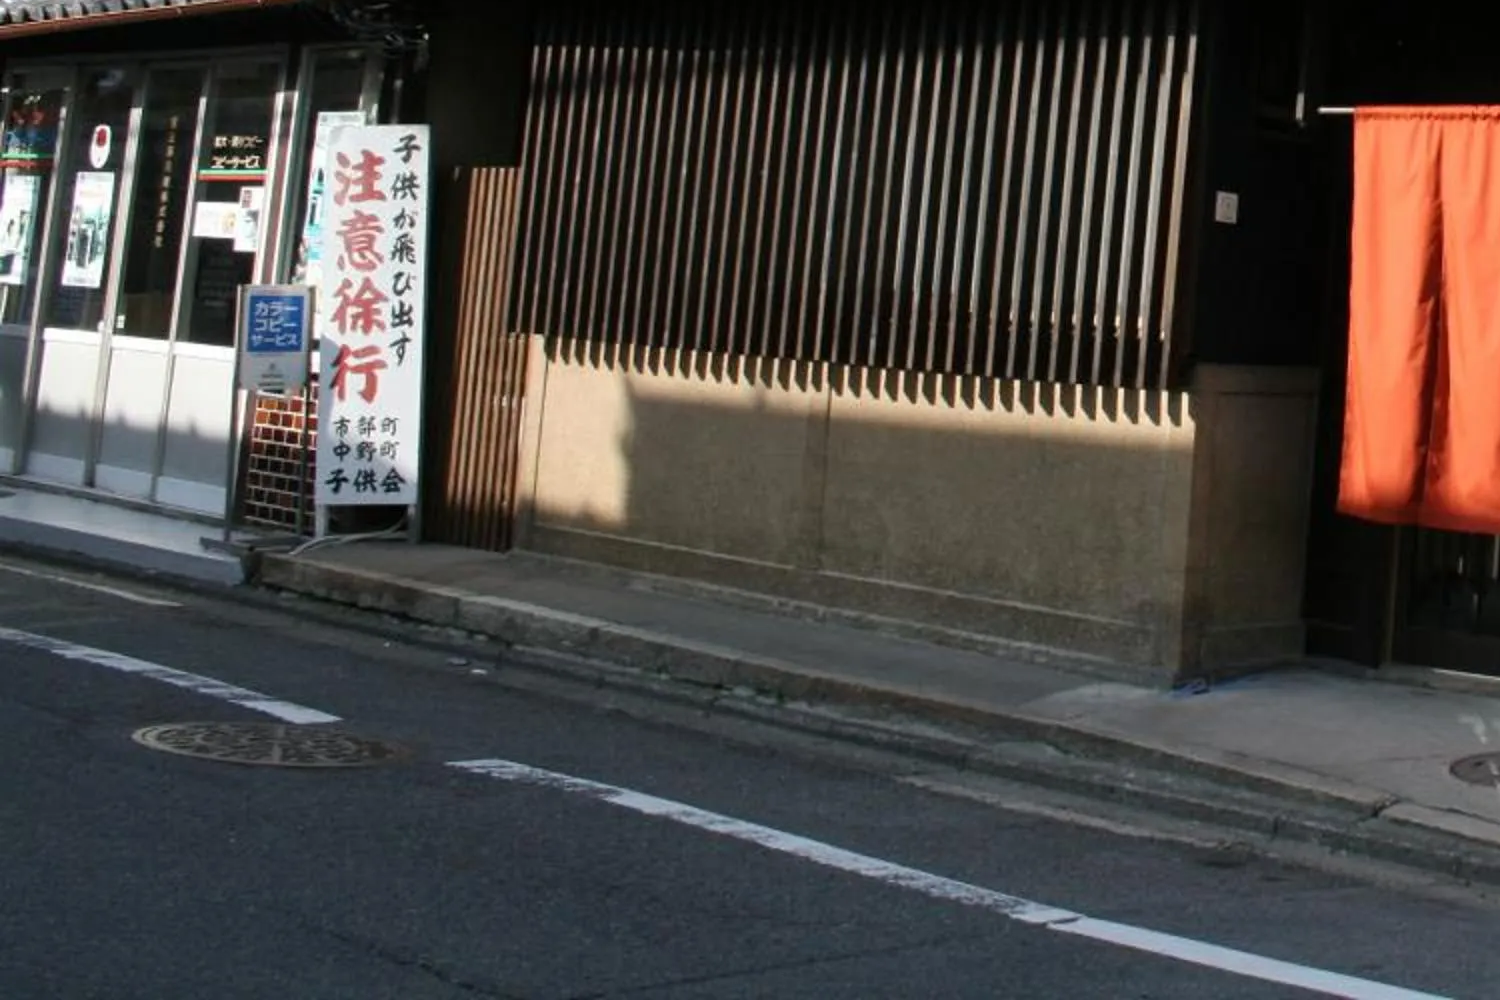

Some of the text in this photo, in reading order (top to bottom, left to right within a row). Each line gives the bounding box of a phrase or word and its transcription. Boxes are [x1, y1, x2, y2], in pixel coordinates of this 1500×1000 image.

[388, 133, 422, 367] 子供が飛び出す
[330, 148, 389, 405] 注意徐行
[254, 301, 299, 317] カラー
[253, 317, 298, 333] コピー
[250, 333, 298, 347] サービス
[332, 416, 399, 438] 市部町
[332, 439, 400, 461] 中野町
[324, 467, 407, 495] 子供会
